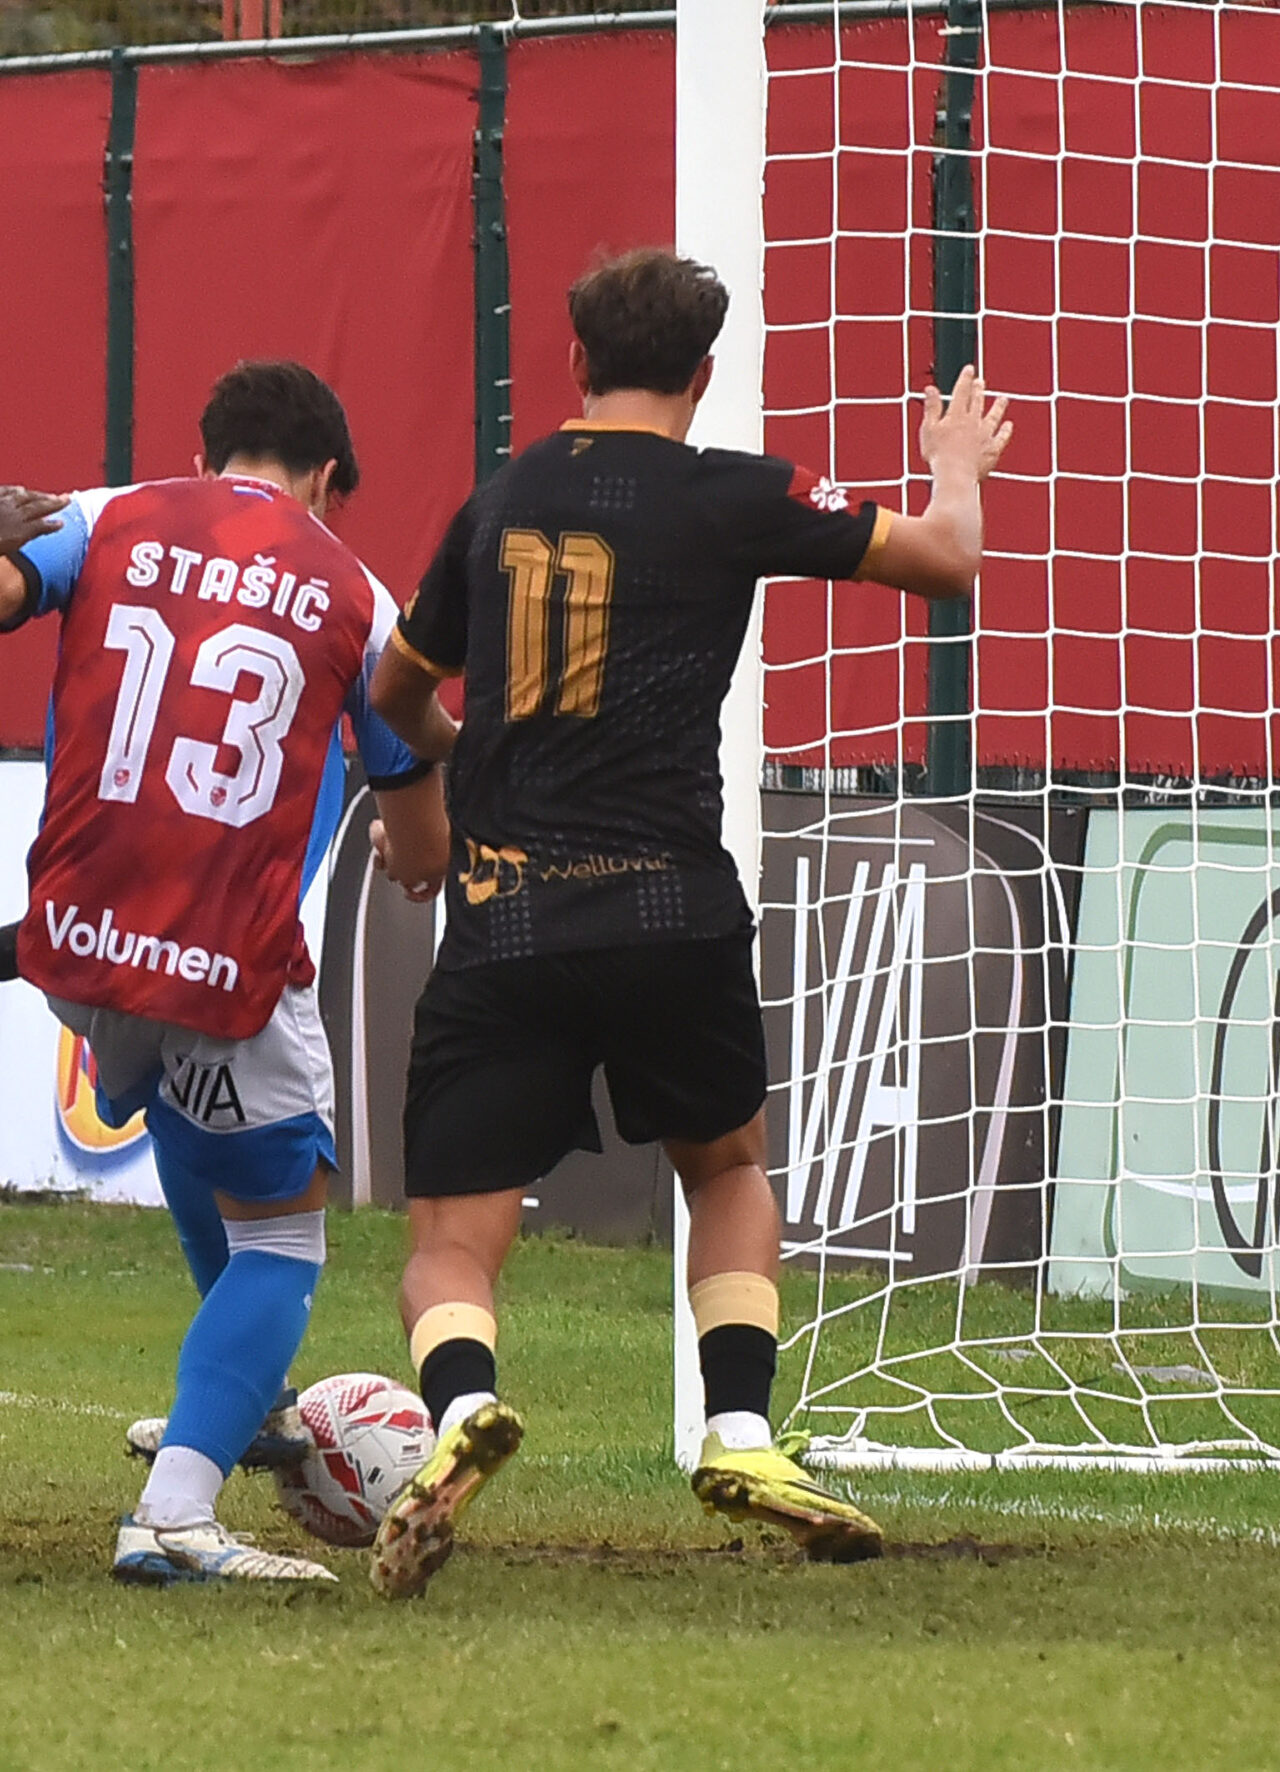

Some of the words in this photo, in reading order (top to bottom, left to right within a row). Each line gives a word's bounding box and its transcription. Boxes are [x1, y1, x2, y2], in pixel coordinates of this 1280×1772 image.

[97, 602, 306, 829] 13
[499, 528, 615, 723] 11
[45, 899, 239, 992] Volumen
